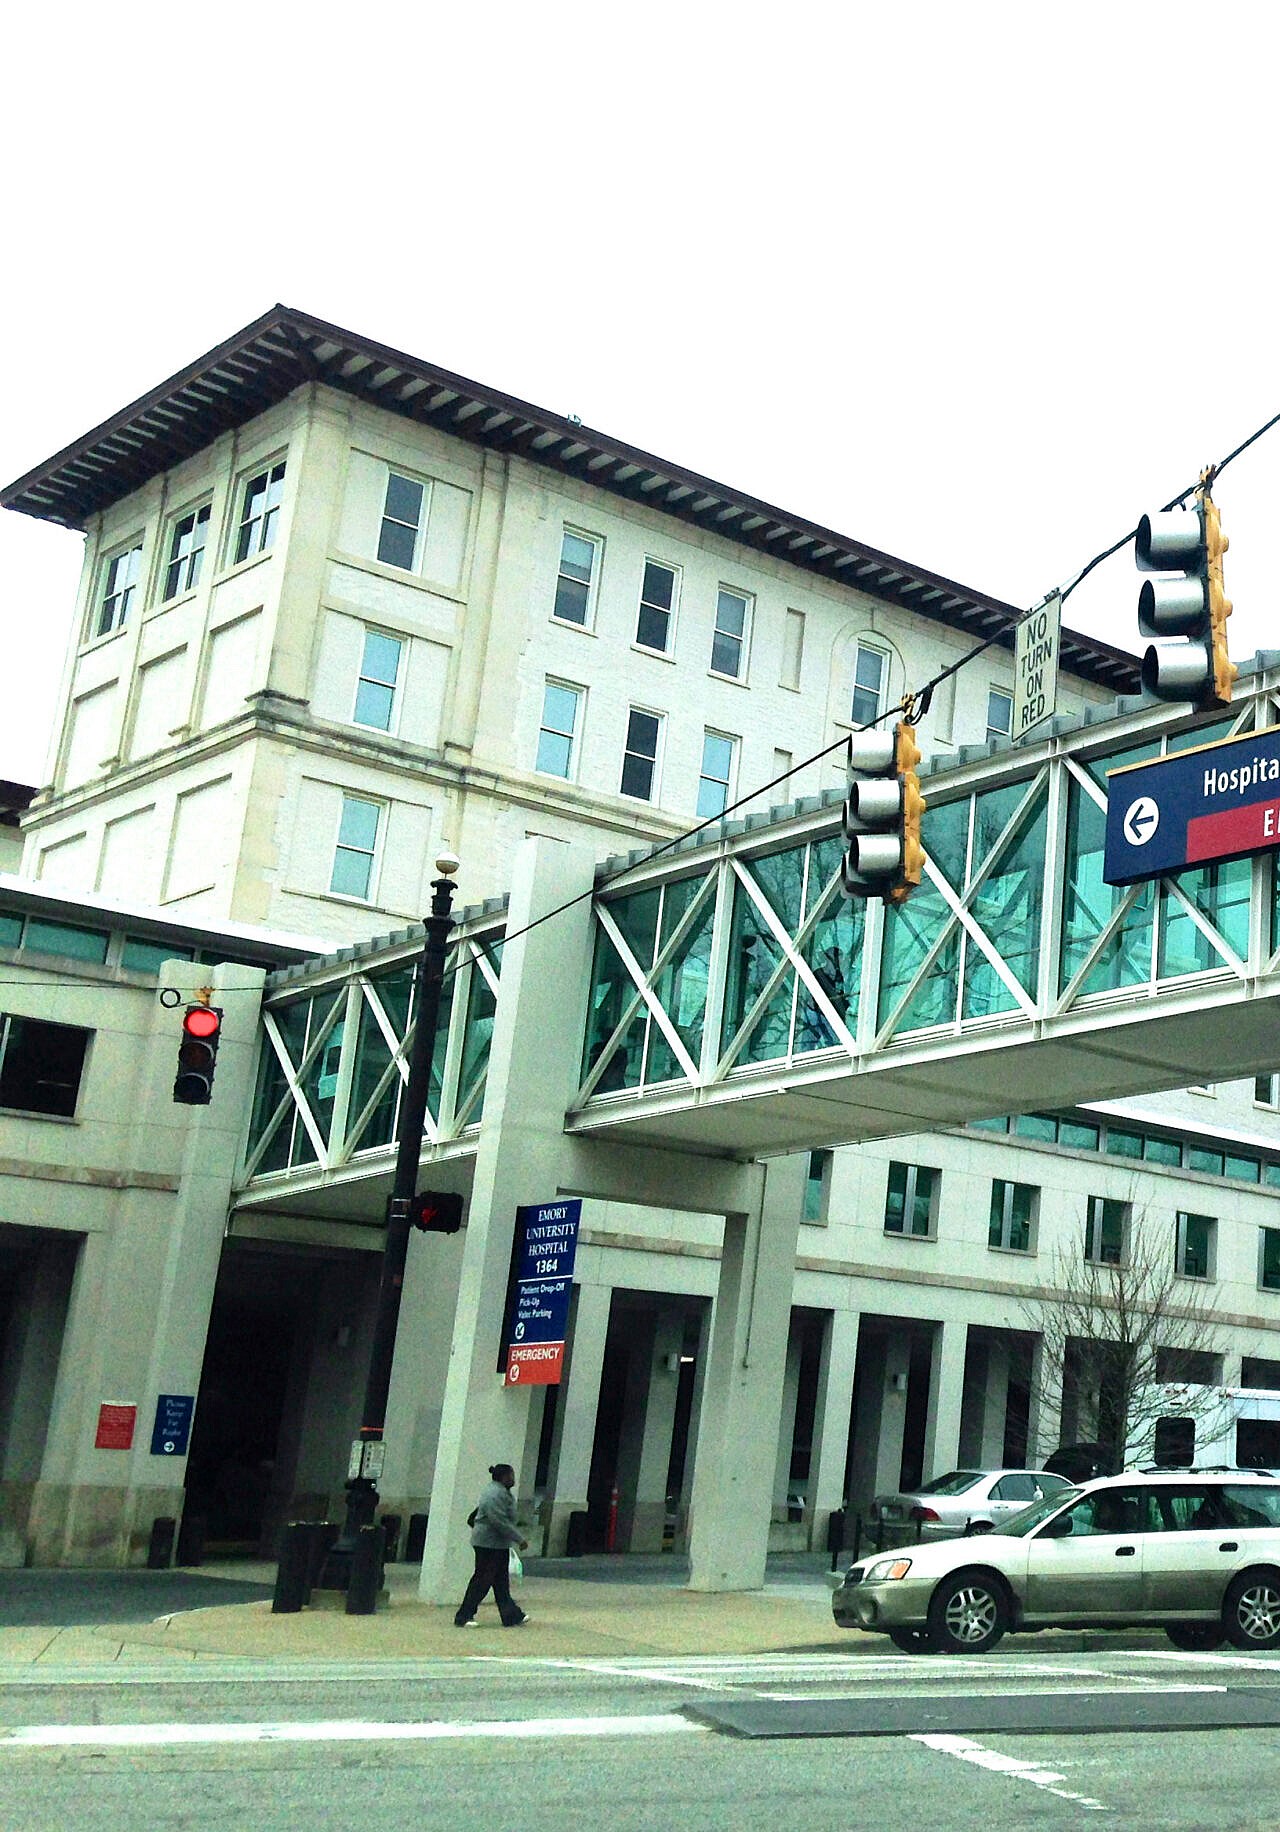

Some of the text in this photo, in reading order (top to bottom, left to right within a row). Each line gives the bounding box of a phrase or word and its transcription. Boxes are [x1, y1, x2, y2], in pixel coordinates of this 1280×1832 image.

[1027, 613, 1047, 649] NO
[1020, 636, 1053, 678] TURN
[1026, 668, 1043, 699] ON
[1021, 693, 1045, 729] RED
[538, 1207, 568, 1221] EMORY
[526, 1222, 576, 1239] UNIVERSITY
[528, 1241, 568, 1256] HOSPITAL
[535, 1258, 558, 1274] 1364
[510, 1347, 560, 1362] EMERGENCY
